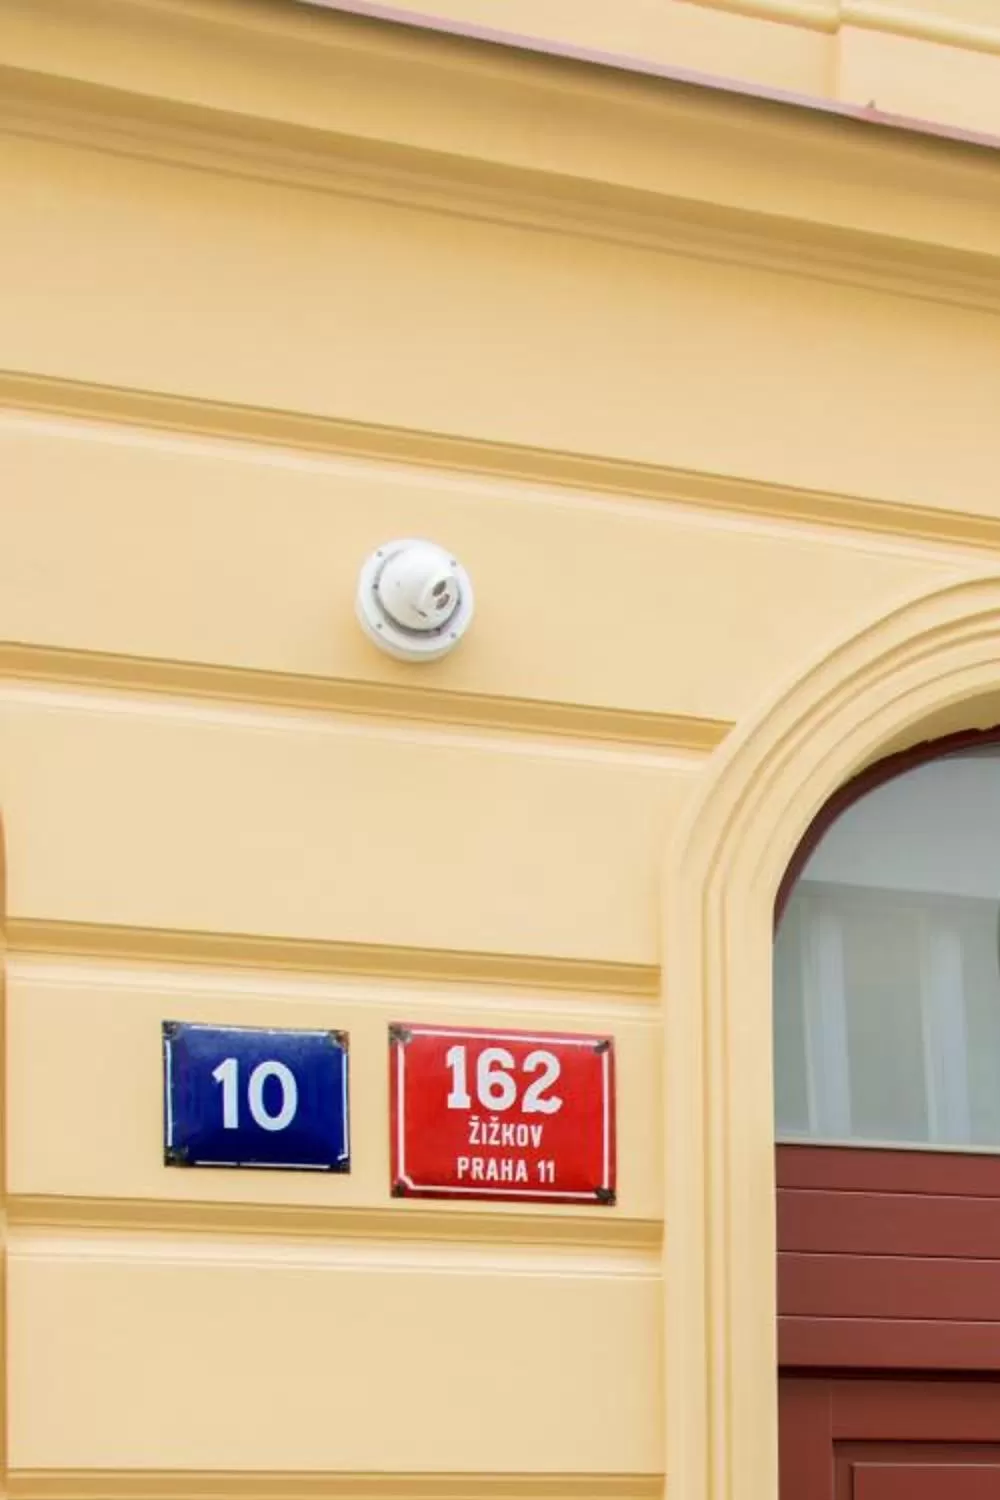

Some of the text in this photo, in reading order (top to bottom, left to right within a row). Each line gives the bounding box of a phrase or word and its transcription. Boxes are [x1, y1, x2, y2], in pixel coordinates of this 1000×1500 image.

[211, 1057, 298, 1132] 10
[446, 1044, 563, 1114] 162
[467, 1115, 543, 1148] ŽIŽKOV
[457, 1157, 555, 1183] PRAHA 11
